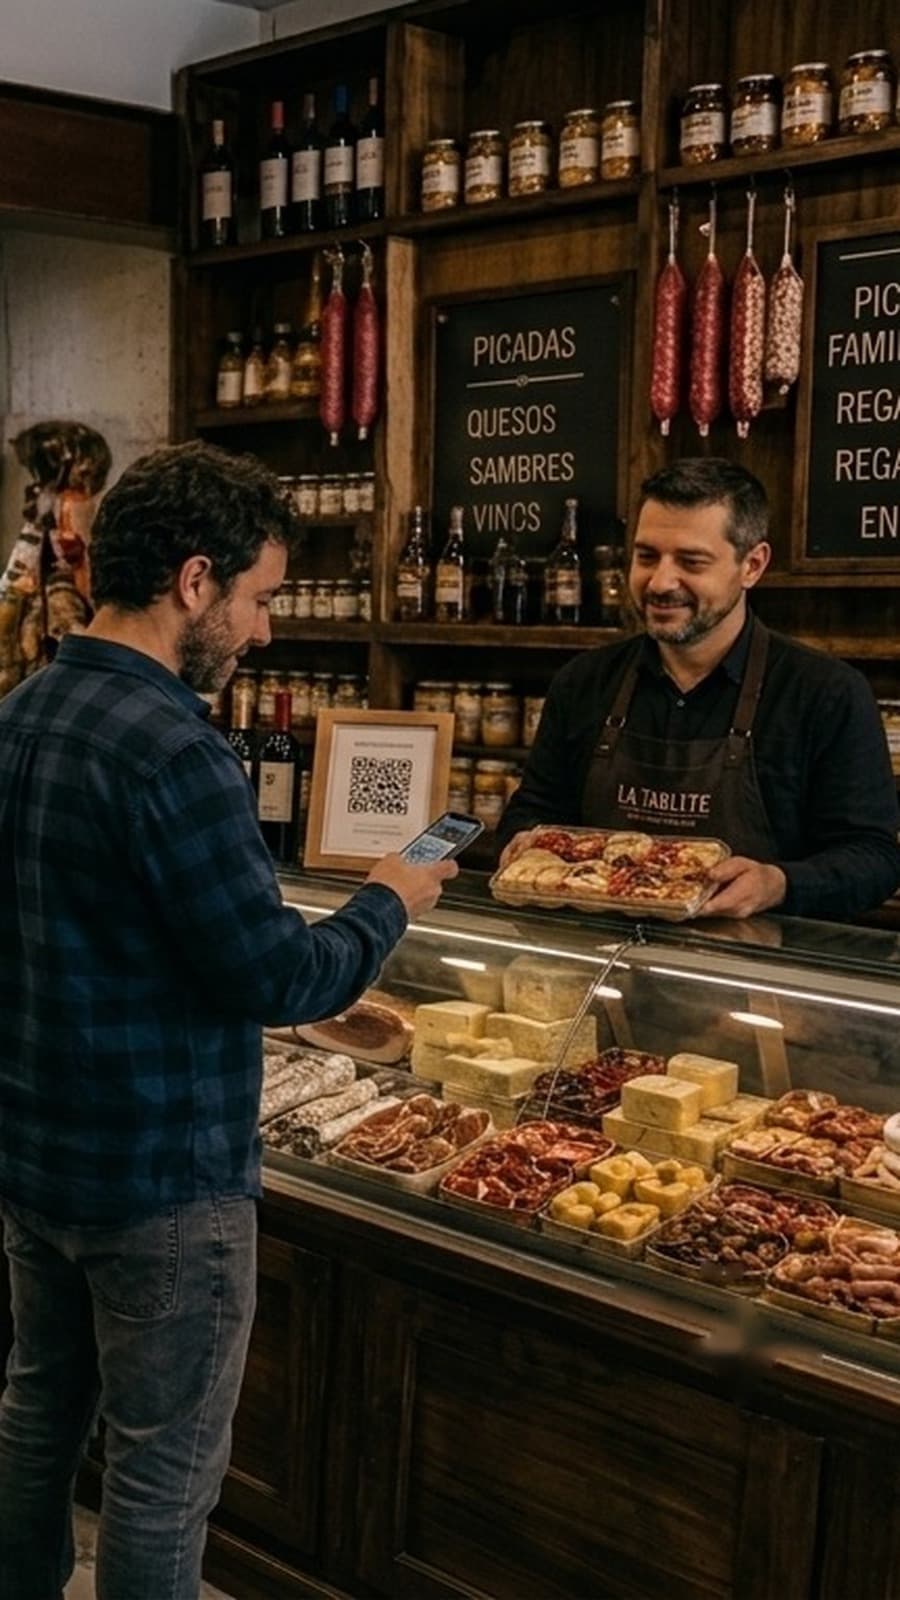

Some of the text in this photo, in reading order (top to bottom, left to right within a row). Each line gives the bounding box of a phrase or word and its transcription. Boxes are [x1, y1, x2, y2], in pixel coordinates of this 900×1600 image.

[854, 282, 900, 320] PIC
[473, 326, 577, 367] PICADAS
[466, 403, 557, 439] QUESOS
[469, 451, 575, 485] SAMBRES
[617, 783, 711, 813] LA TABLITE
